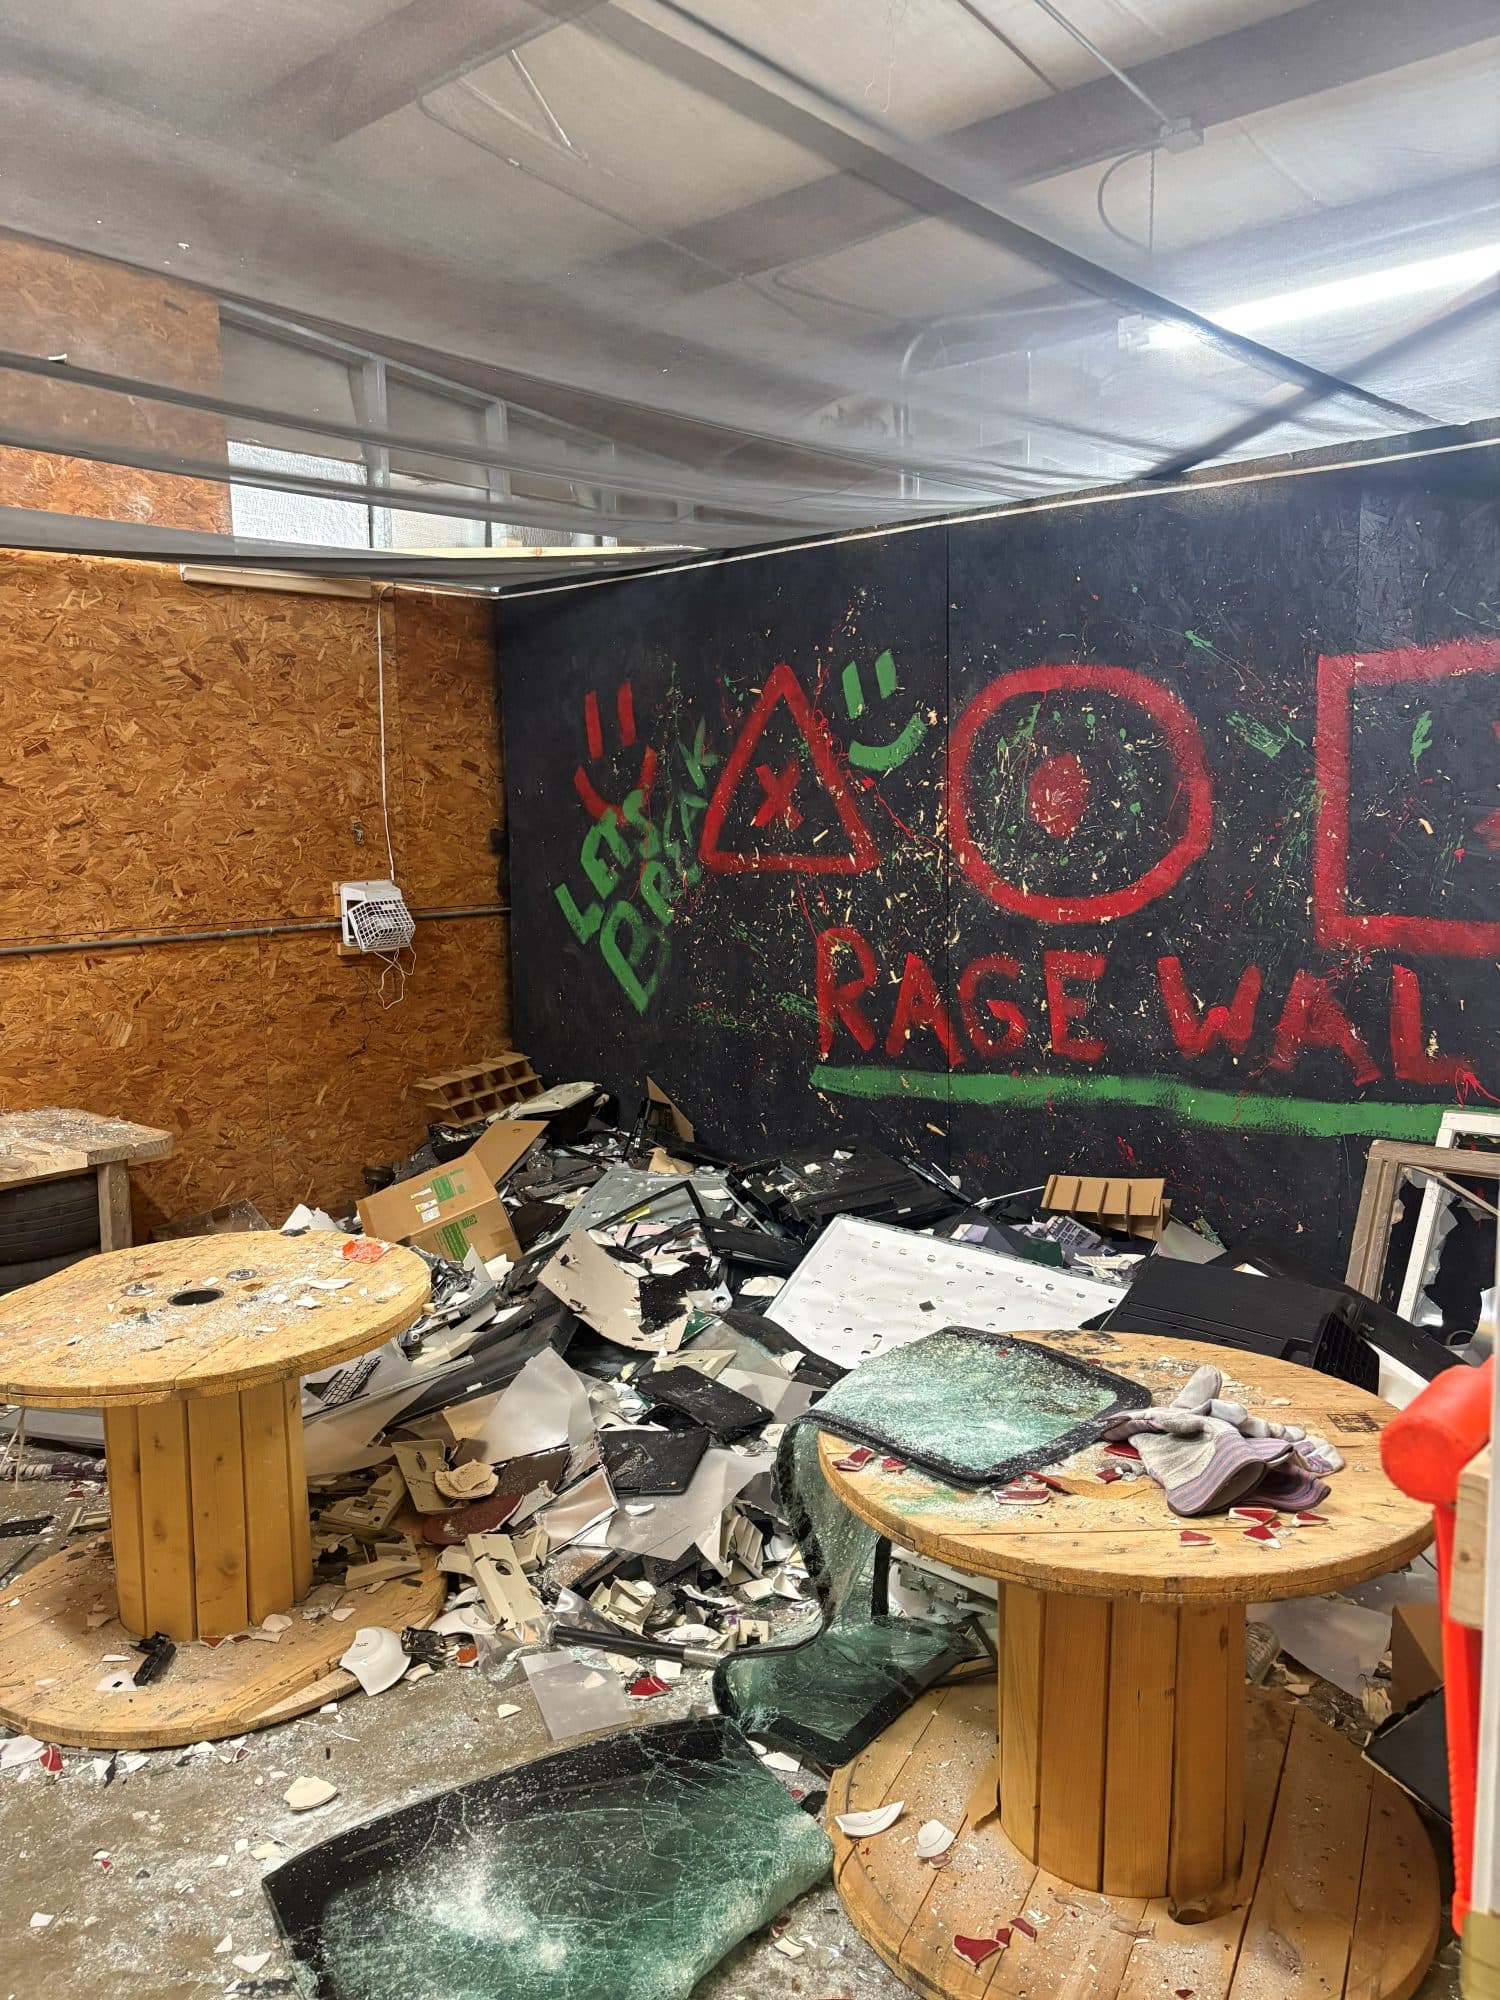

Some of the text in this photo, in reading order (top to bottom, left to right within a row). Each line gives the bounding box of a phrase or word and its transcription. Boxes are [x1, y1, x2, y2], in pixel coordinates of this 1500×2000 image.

[553, 788, 661, 945] LETS
[600, 715, 718, 1016] BREAK
[814, 926, 1106, 1067] RAGE
